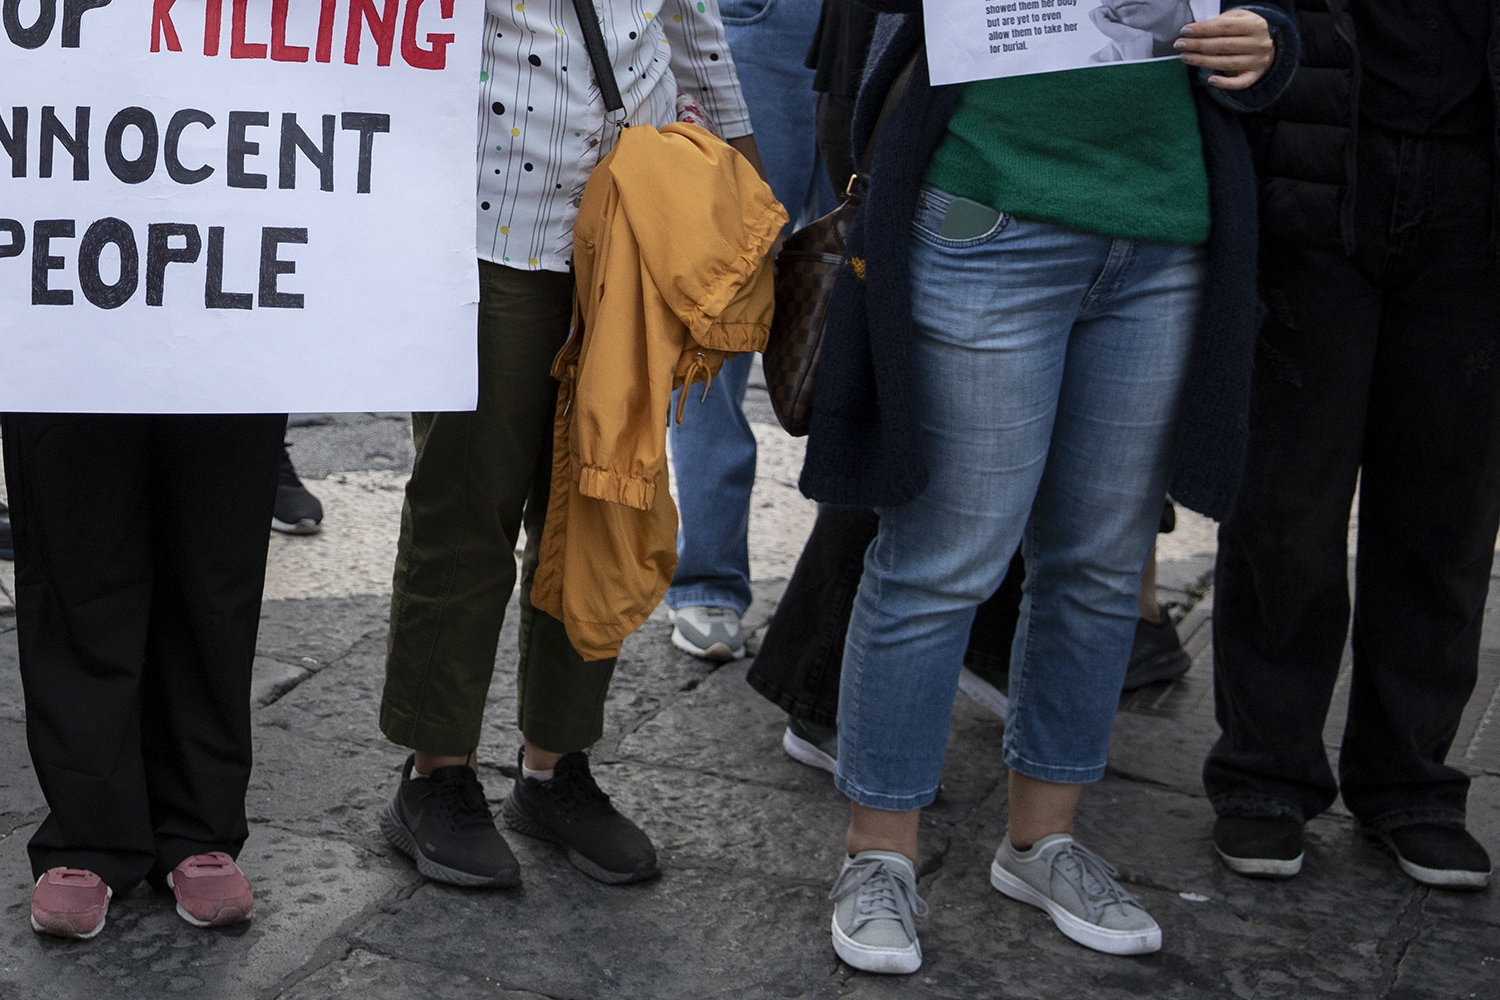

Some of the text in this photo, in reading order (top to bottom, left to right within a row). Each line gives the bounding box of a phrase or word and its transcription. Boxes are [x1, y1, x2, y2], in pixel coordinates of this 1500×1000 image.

[986, 3, 1016, 14] showed
[1019, 1, 1039, 10] them
[1041, 0, 1054, 8] her
[987, 12, 1061, 27] but are yet to even
[989, 23, 1077, 40] allow them to take her
[990, 41, 1028, 54] for burial.
